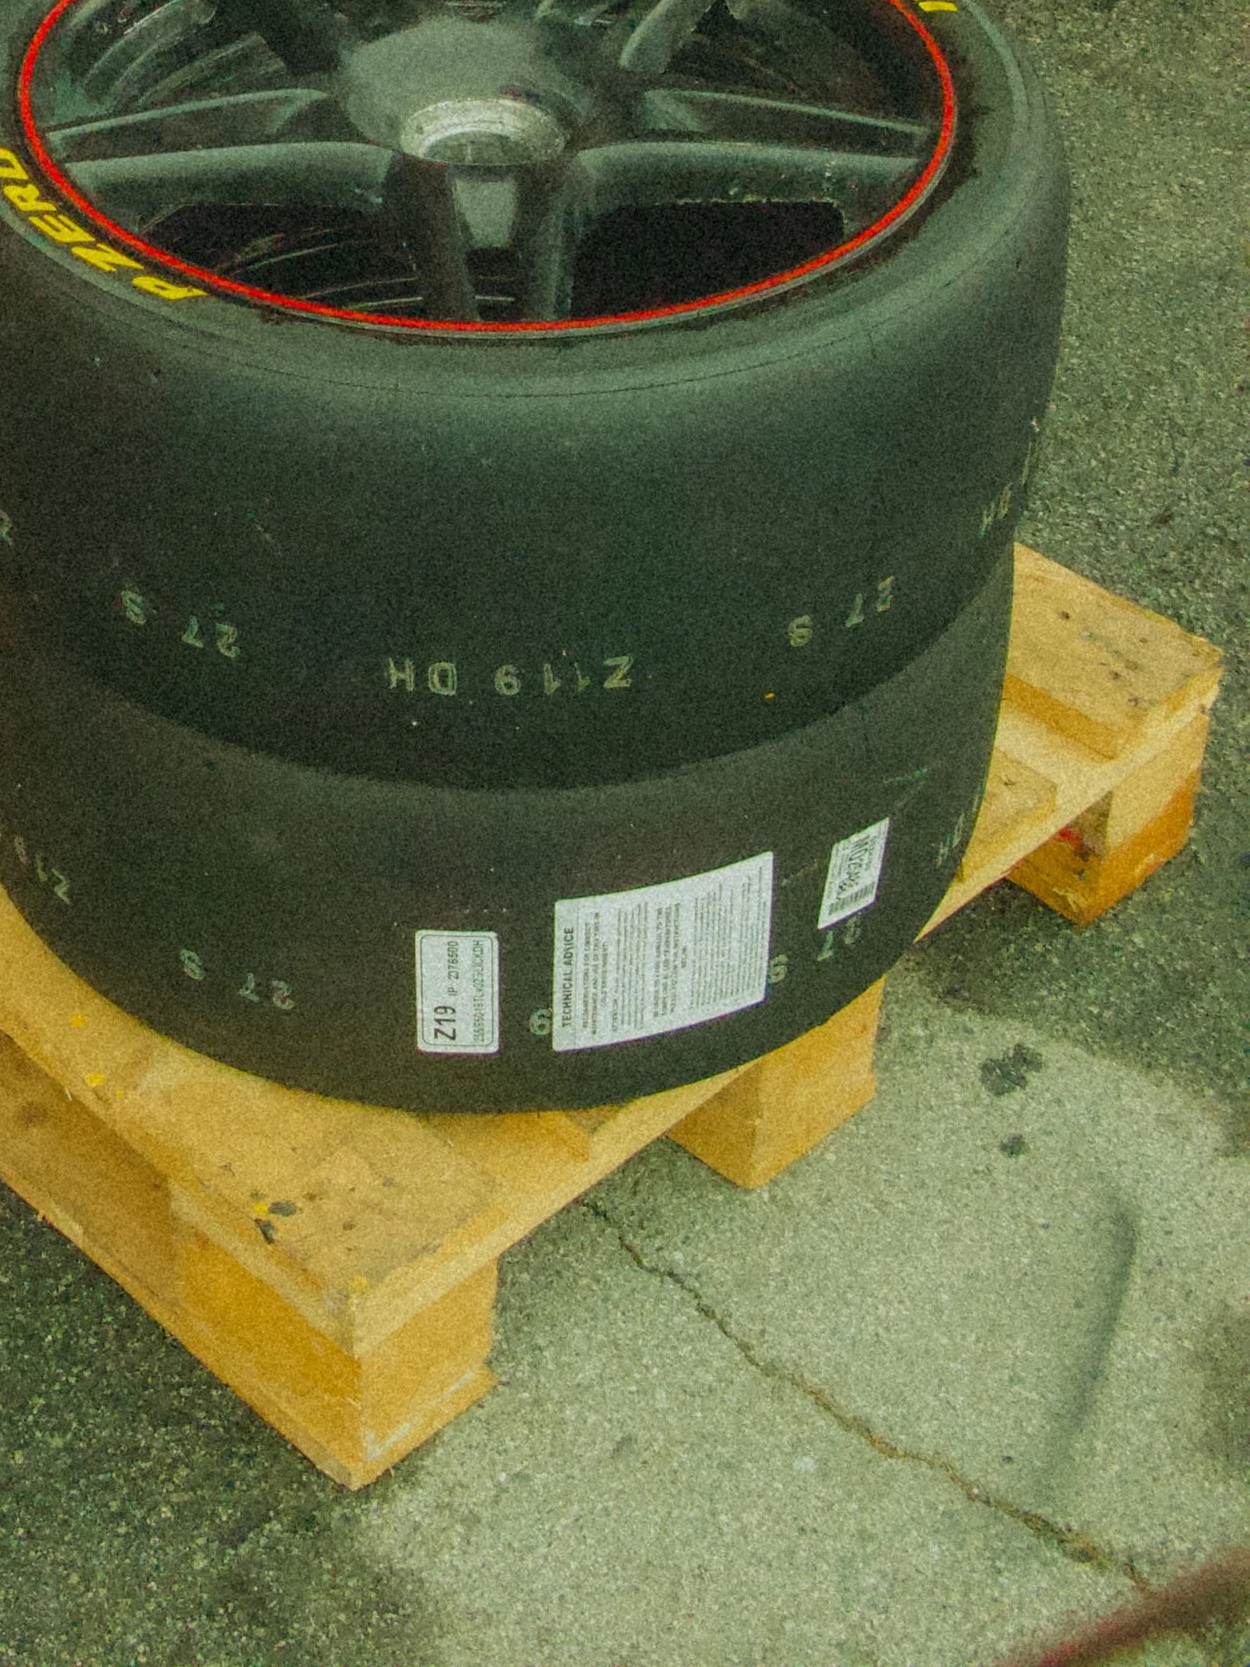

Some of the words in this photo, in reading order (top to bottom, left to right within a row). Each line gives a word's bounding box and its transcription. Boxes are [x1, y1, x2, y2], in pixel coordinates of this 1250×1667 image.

[562, 925, 573, 967] ADVICE
[561, 969, 572, 1028] TECHNICAL
[433, 1005, 456, 1041] Z19
